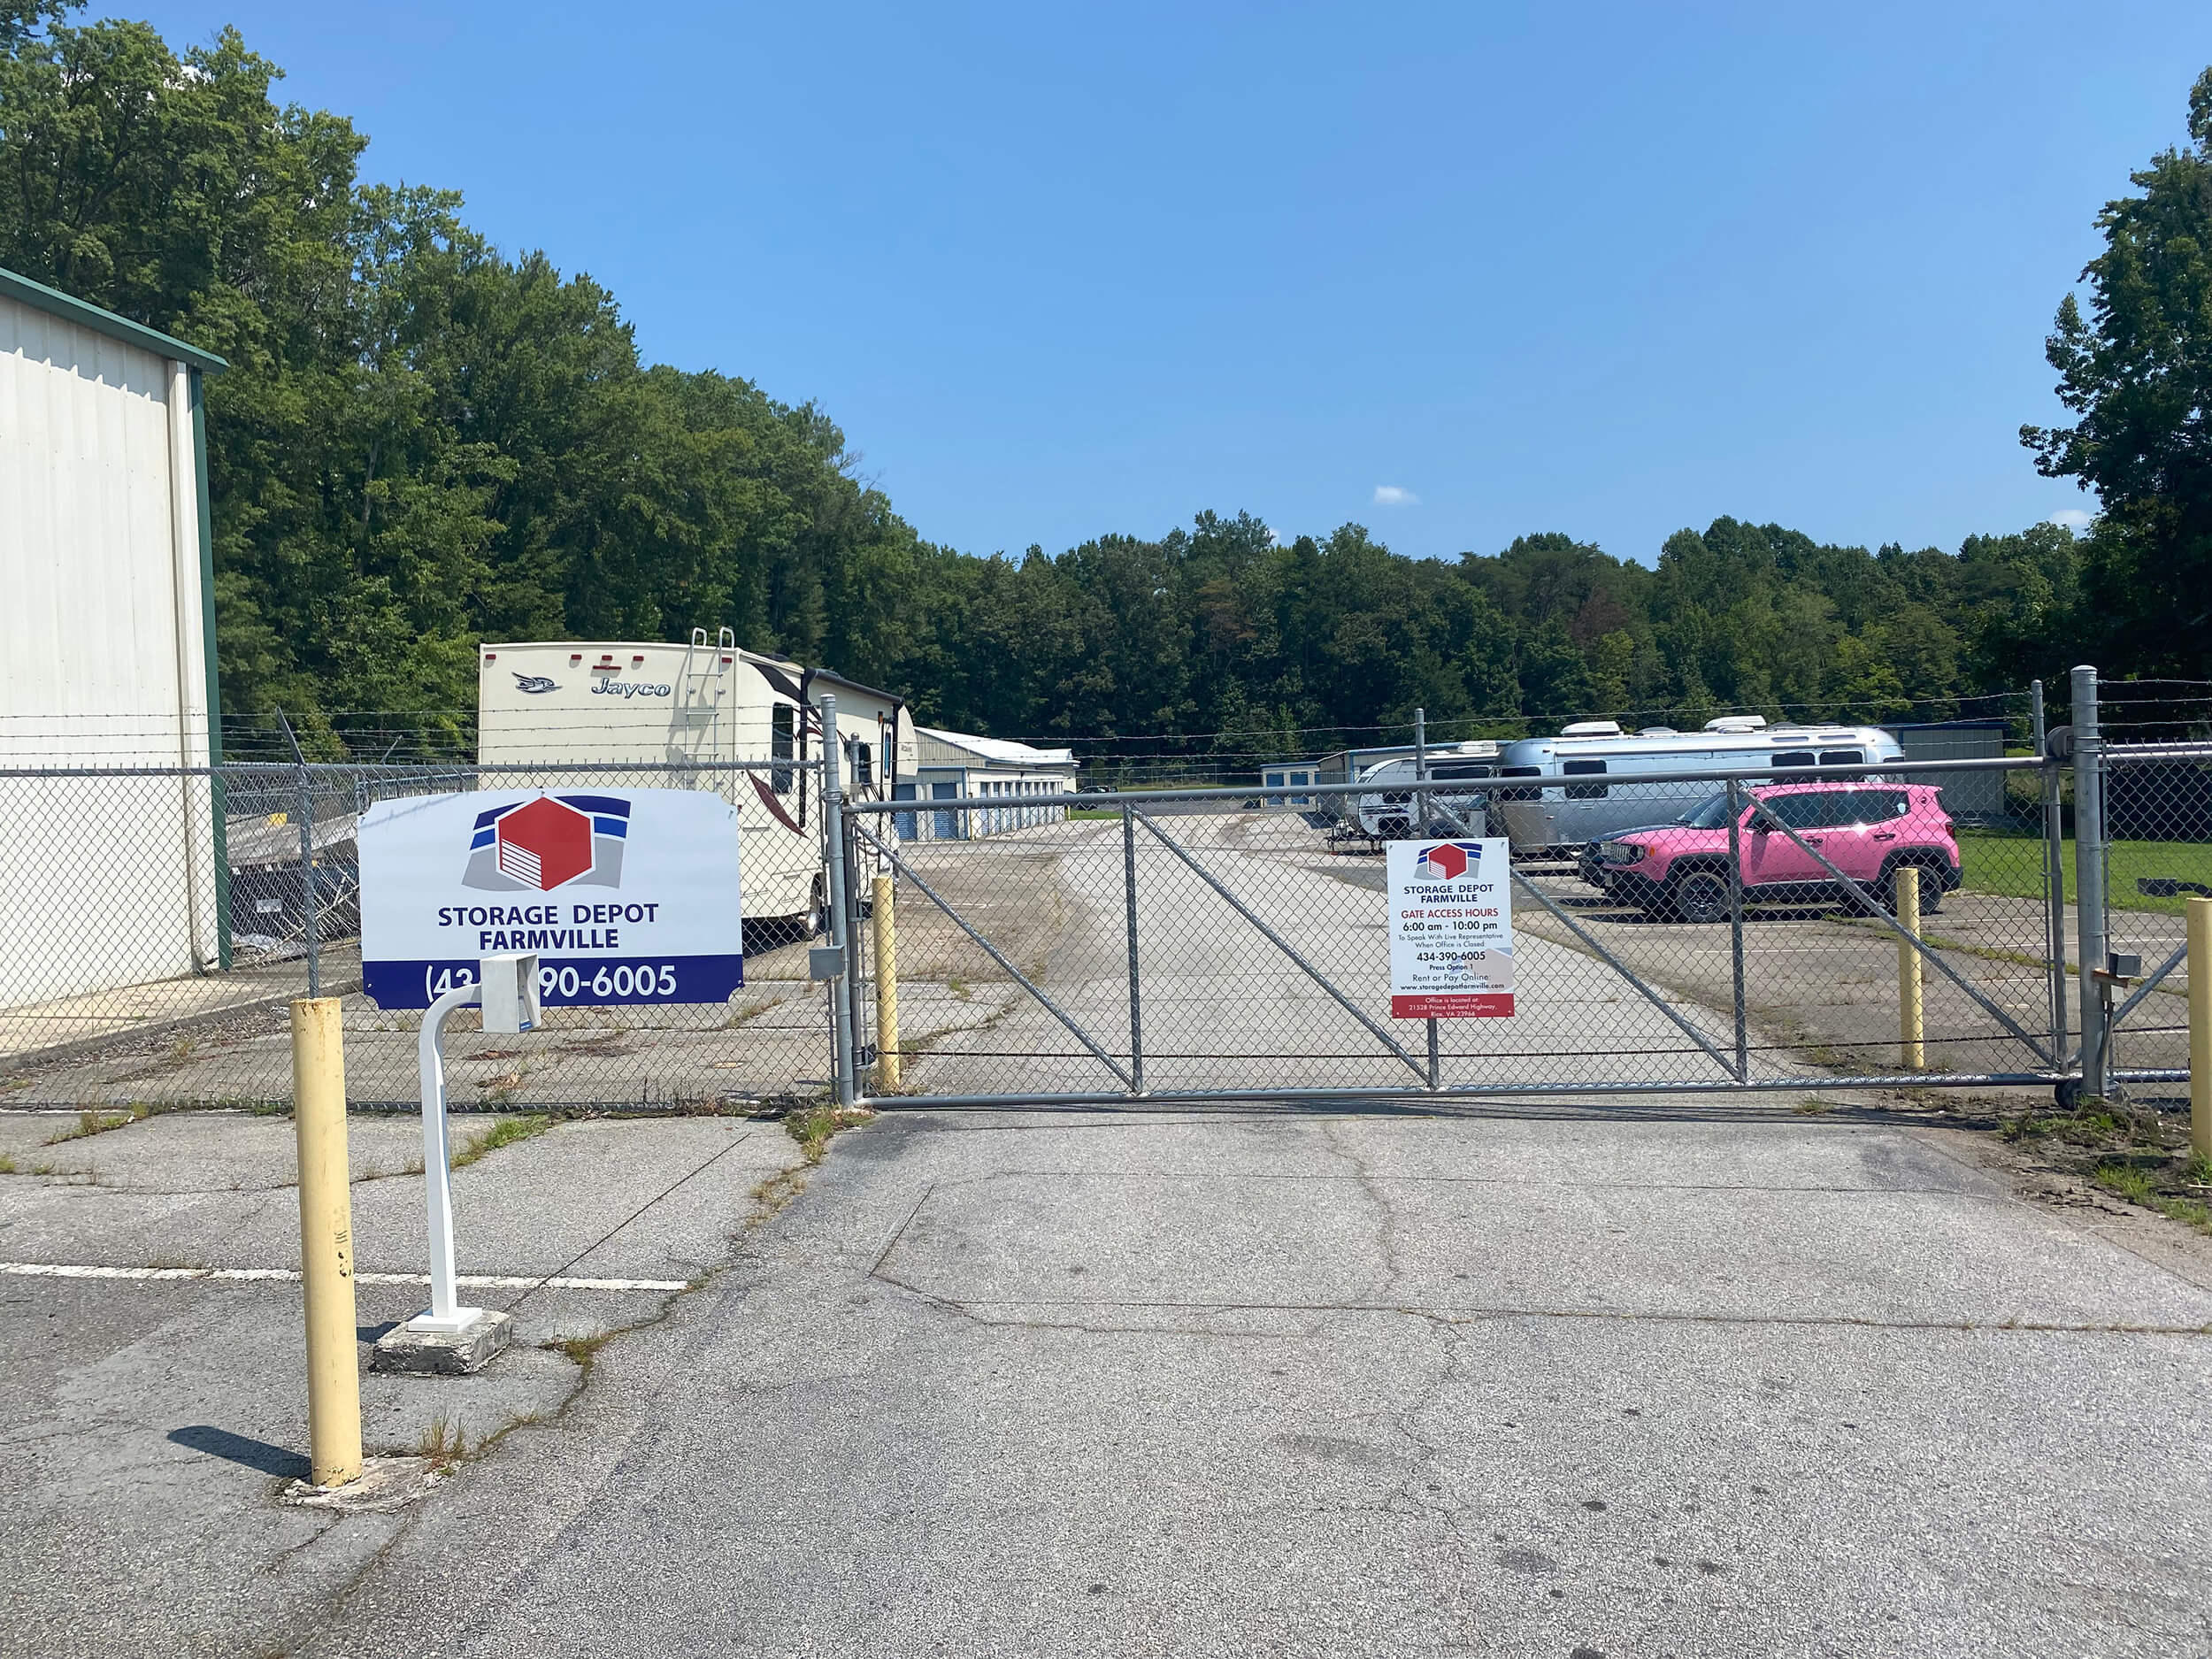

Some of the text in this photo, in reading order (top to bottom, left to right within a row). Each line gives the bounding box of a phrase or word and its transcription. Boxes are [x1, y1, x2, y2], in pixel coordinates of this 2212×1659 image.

[591, 677, 671, 699] Jayco
[1403, 886, 1453, 895] STORAGE
[1421, 895, 1478, 903] FARMVILLE
[438, 903, 658, 926] STORAGE DEPOT
[1427, 910, 1463, 918] ACCESS
[1465, 908, 1499, 917] HOURS
[1402, 922, 1425, 932] 6:00
[1453, 921, 1480, 930] 10:00
[1483, 923, 1498, 932] pm
[480, 929, 619, 950] FARMVILLE
[1417, 951, 1486, 961] 434-390-6005
[1444, 974, 1459, 983] Pay
[1401, 982, 1504, 991] www.storagedepotfarmville.com
